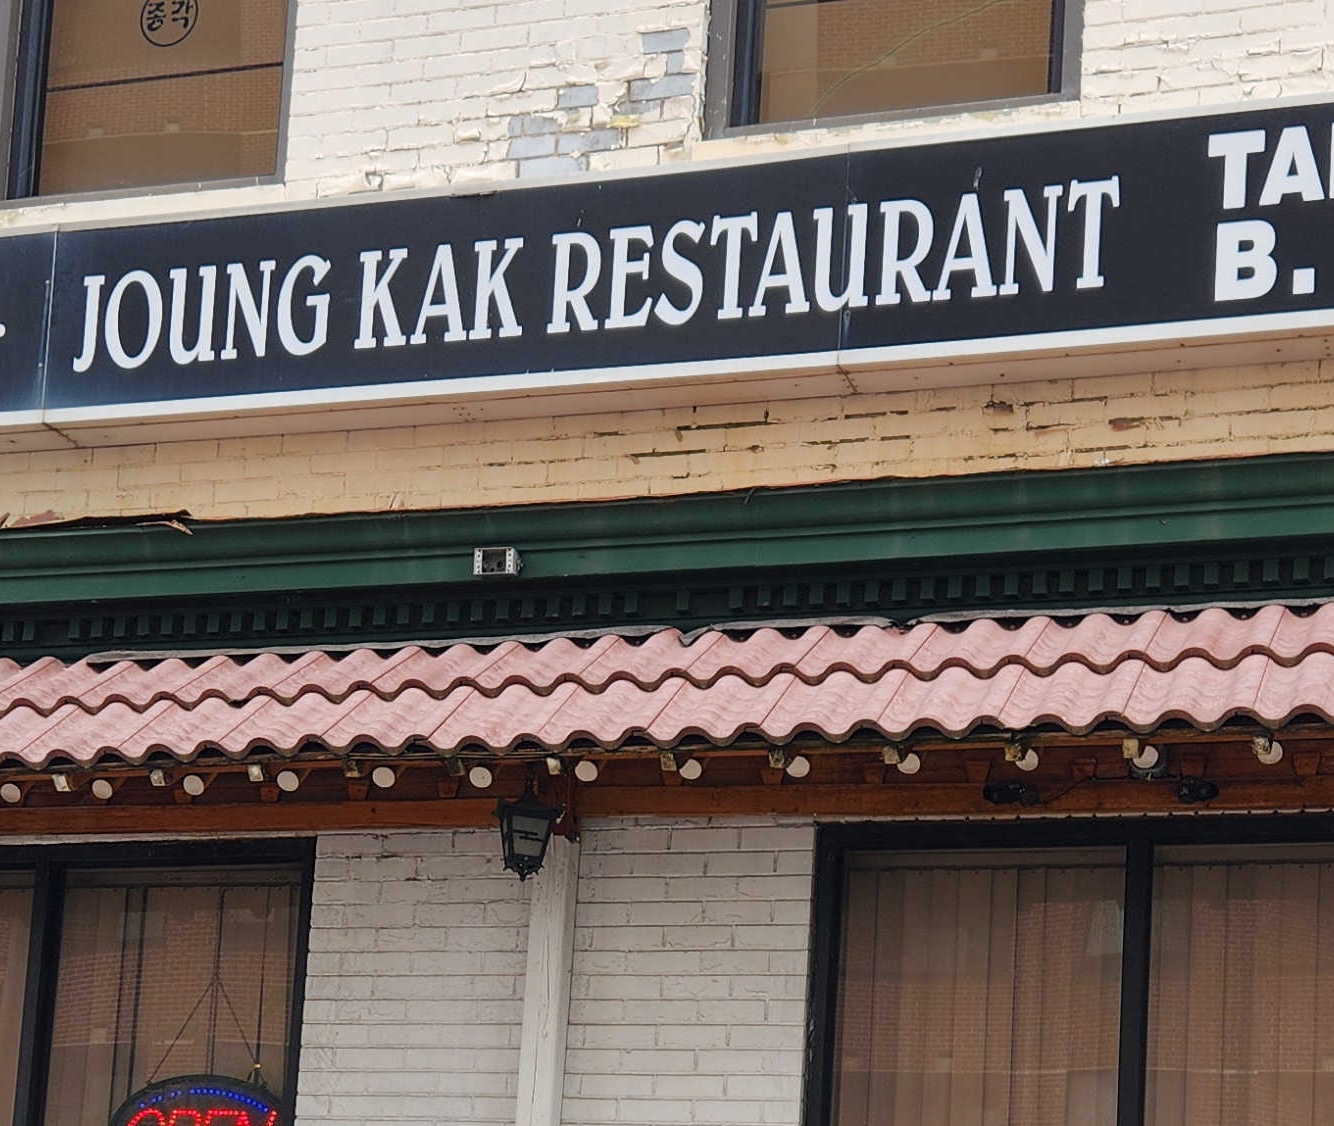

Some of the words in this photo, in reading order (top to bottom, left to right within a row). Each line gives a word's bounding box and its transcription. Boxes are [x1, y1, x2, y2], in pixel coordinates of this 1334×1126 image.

[146, 0, 194, 32] 종각
[72, 253, 332, 373] JOUNG
[353, 236, 525, 350] KAK
[546, 175, 1121, 335] RESTAURANT
[1214, 219, 1316, 303] B.
